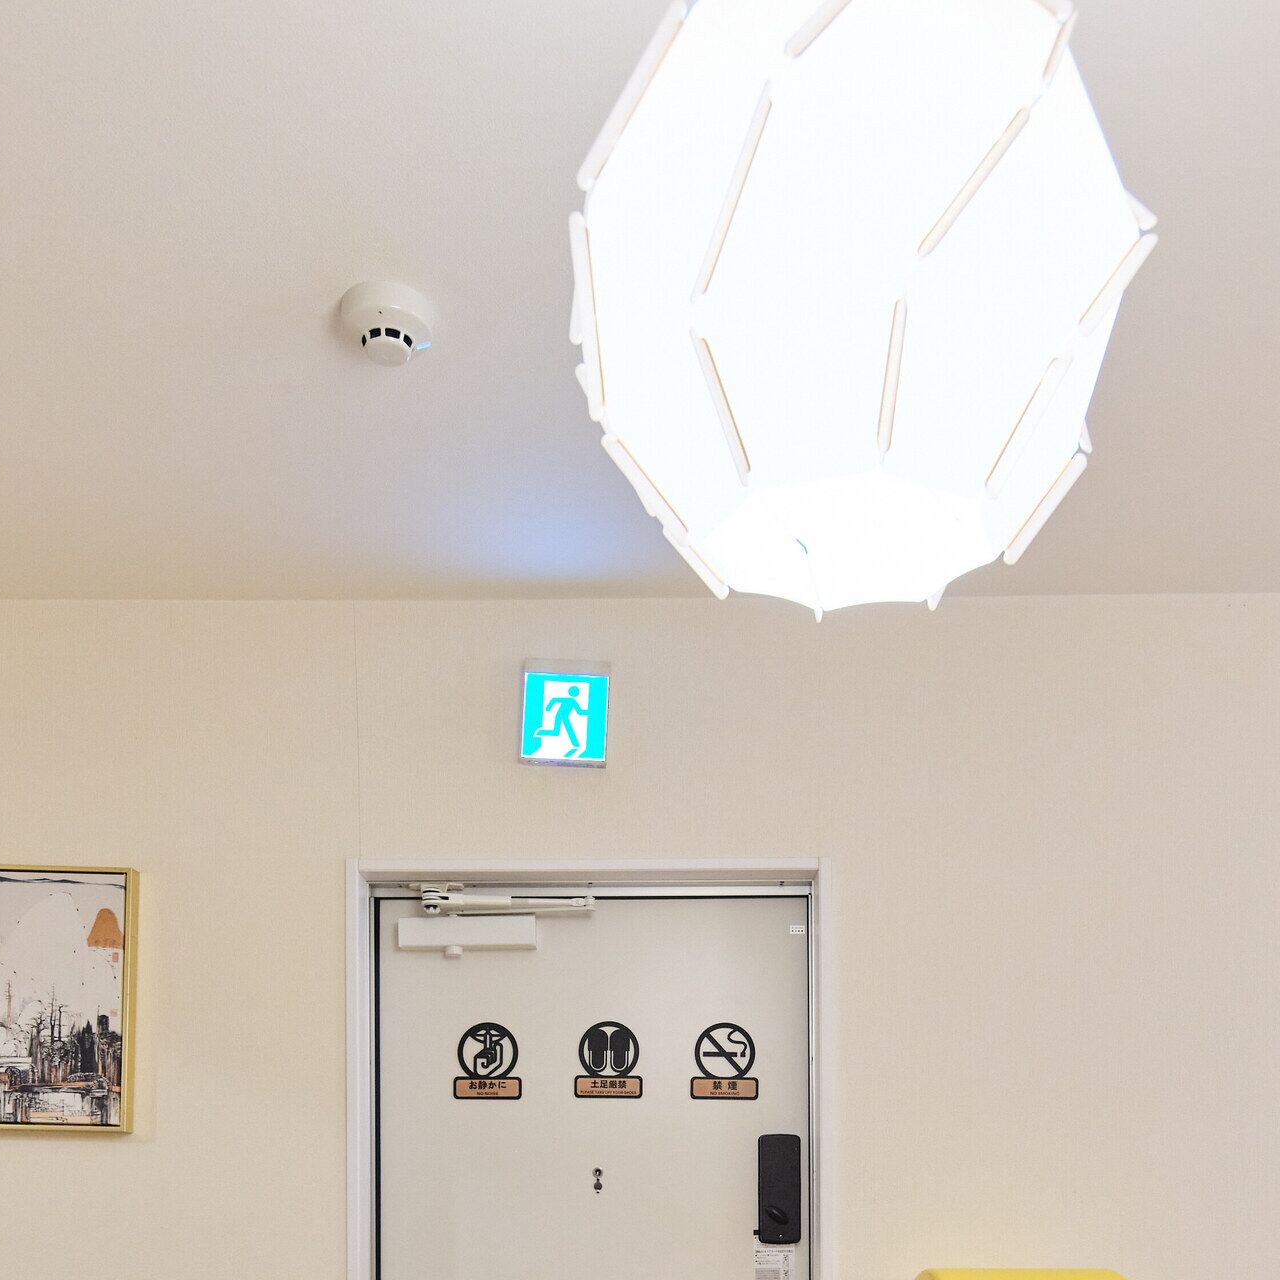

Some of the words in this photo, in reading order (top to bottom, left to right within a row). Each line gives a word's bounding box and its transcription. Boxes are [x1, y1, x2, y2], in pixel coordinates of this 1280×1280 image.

[468, 1080, 507, 1090] お静かに
[590, 1079, 627, 1089] 土足厳禁
[712, 1080, 738, 1091] 禁煙
